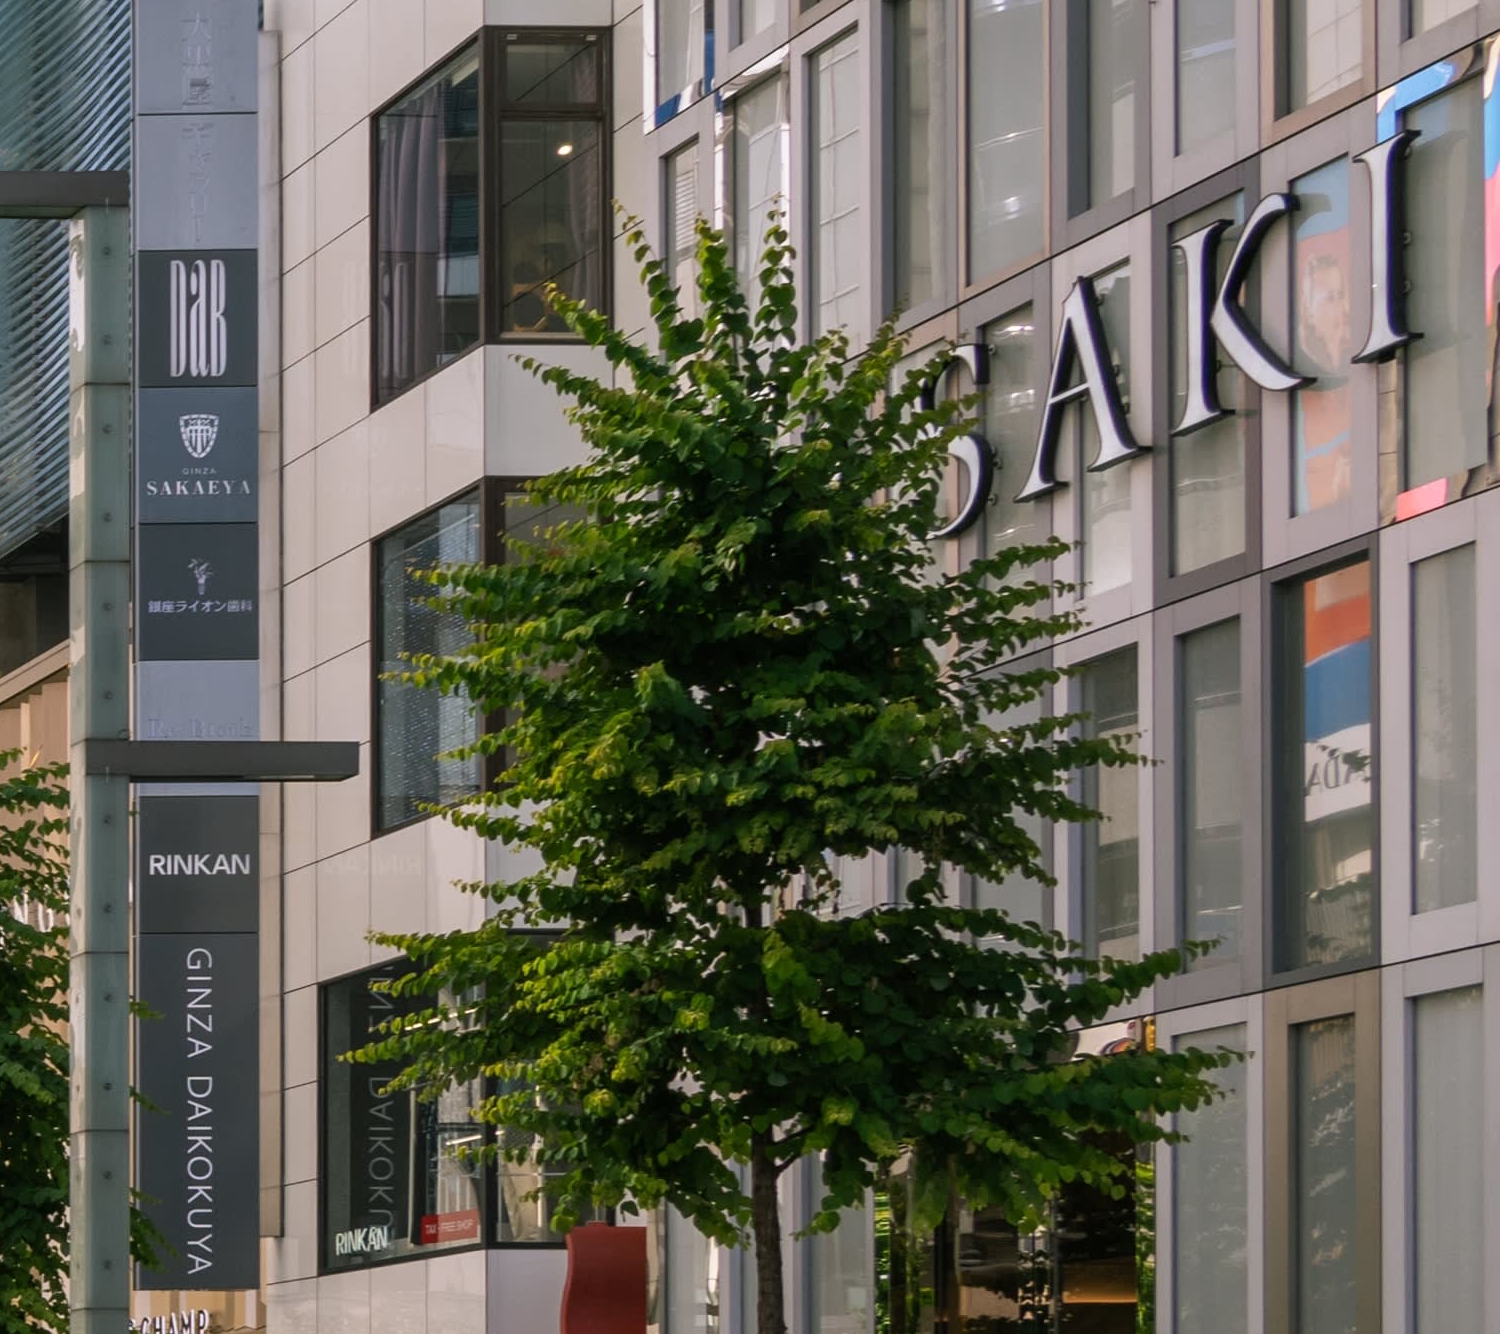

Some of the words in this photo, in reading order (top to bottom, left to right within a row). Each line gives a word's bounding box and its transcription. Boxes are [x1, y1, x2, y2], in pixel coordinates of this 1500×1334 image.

[921, 129, 1424, 541] SAKI
[146, 480, 252, 496] SAKAEYA
[147, 598, 253, 614] 銀座ライオン歯科
[149, 853, 251, 876] RINKAN
[186, 947, 213, 1060] GINZA
[186, 1076, 213, 1275] DAIKOKUYA
[336, 1225, 388, 1257] RINKAN
